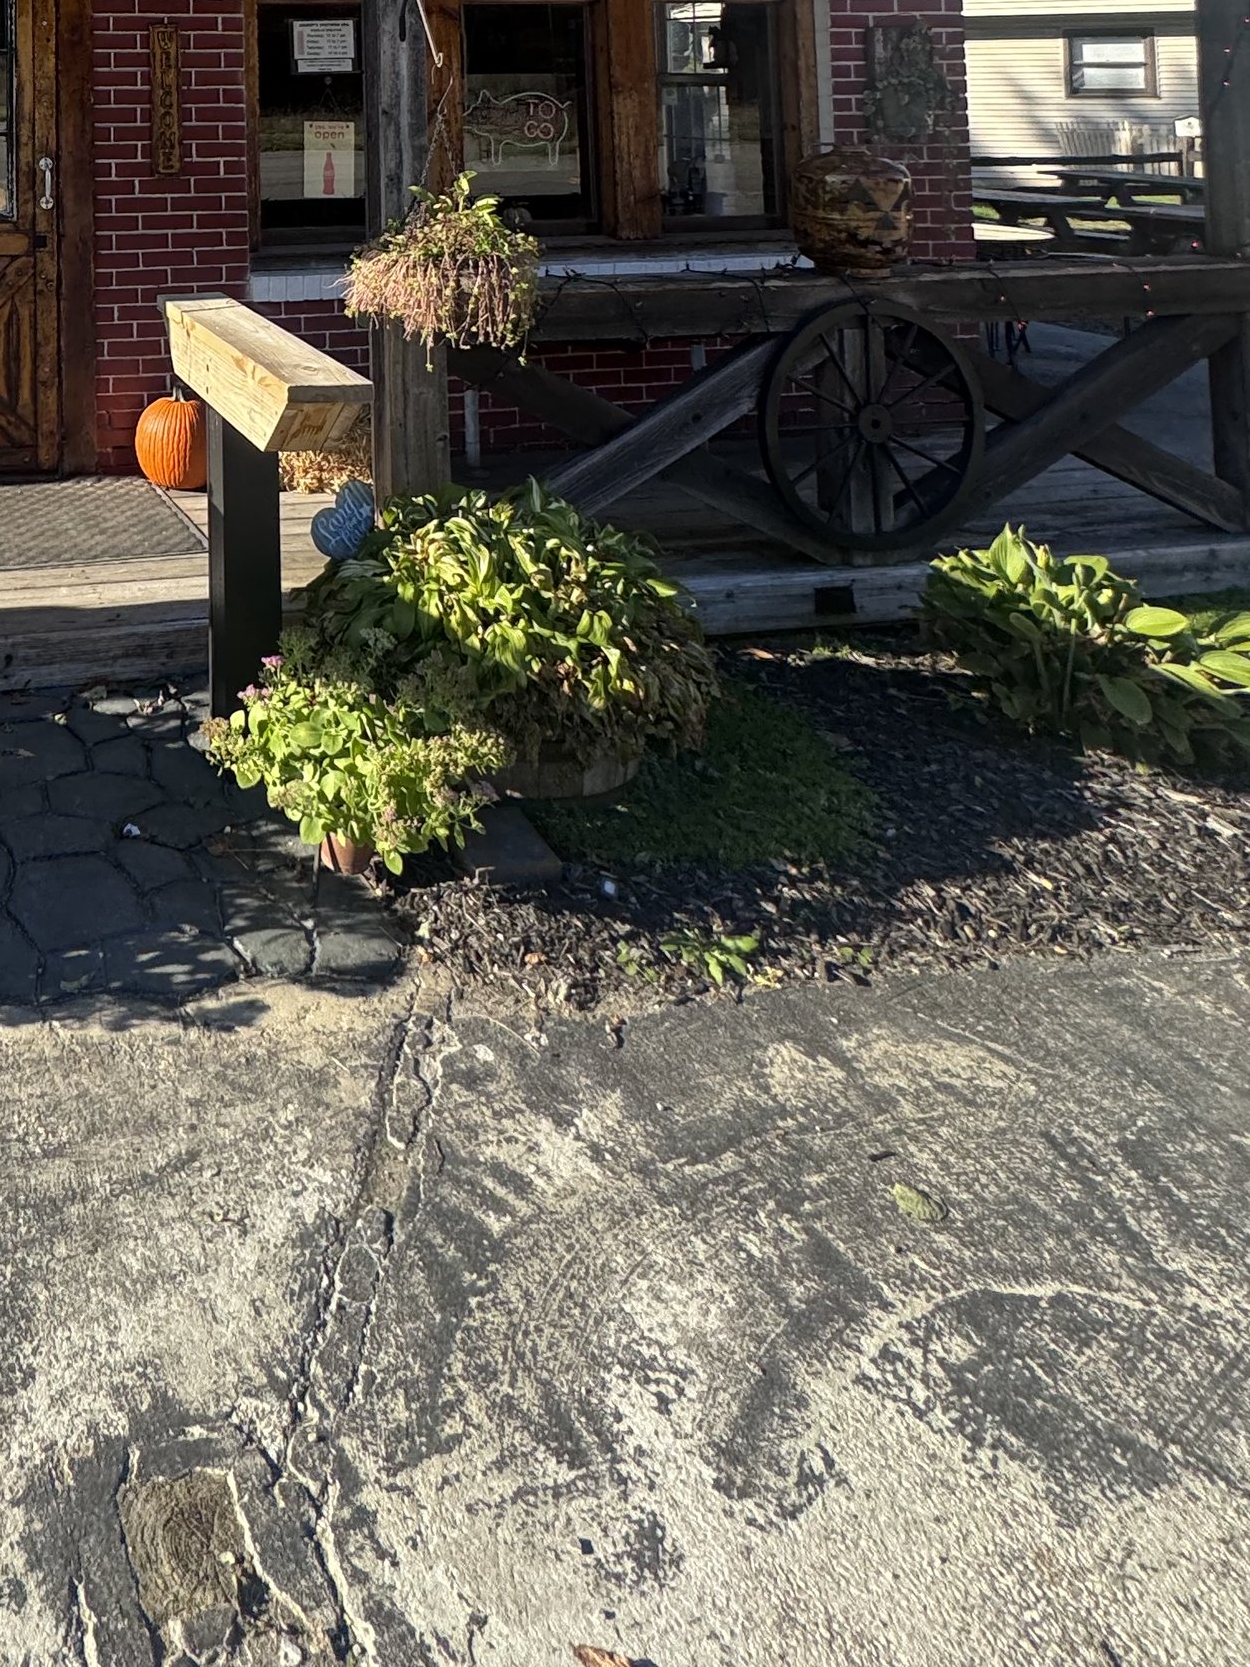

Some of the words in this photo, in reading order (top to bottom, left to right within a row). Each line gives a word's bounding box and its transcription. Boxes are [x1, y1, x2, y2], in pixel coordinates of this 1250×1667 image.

[157, 30, 176, 171] WELCOME
[525, 99, 556, 119] TO
[314, 131, 345, 141] open
[524, 120, 554, 139] GO
